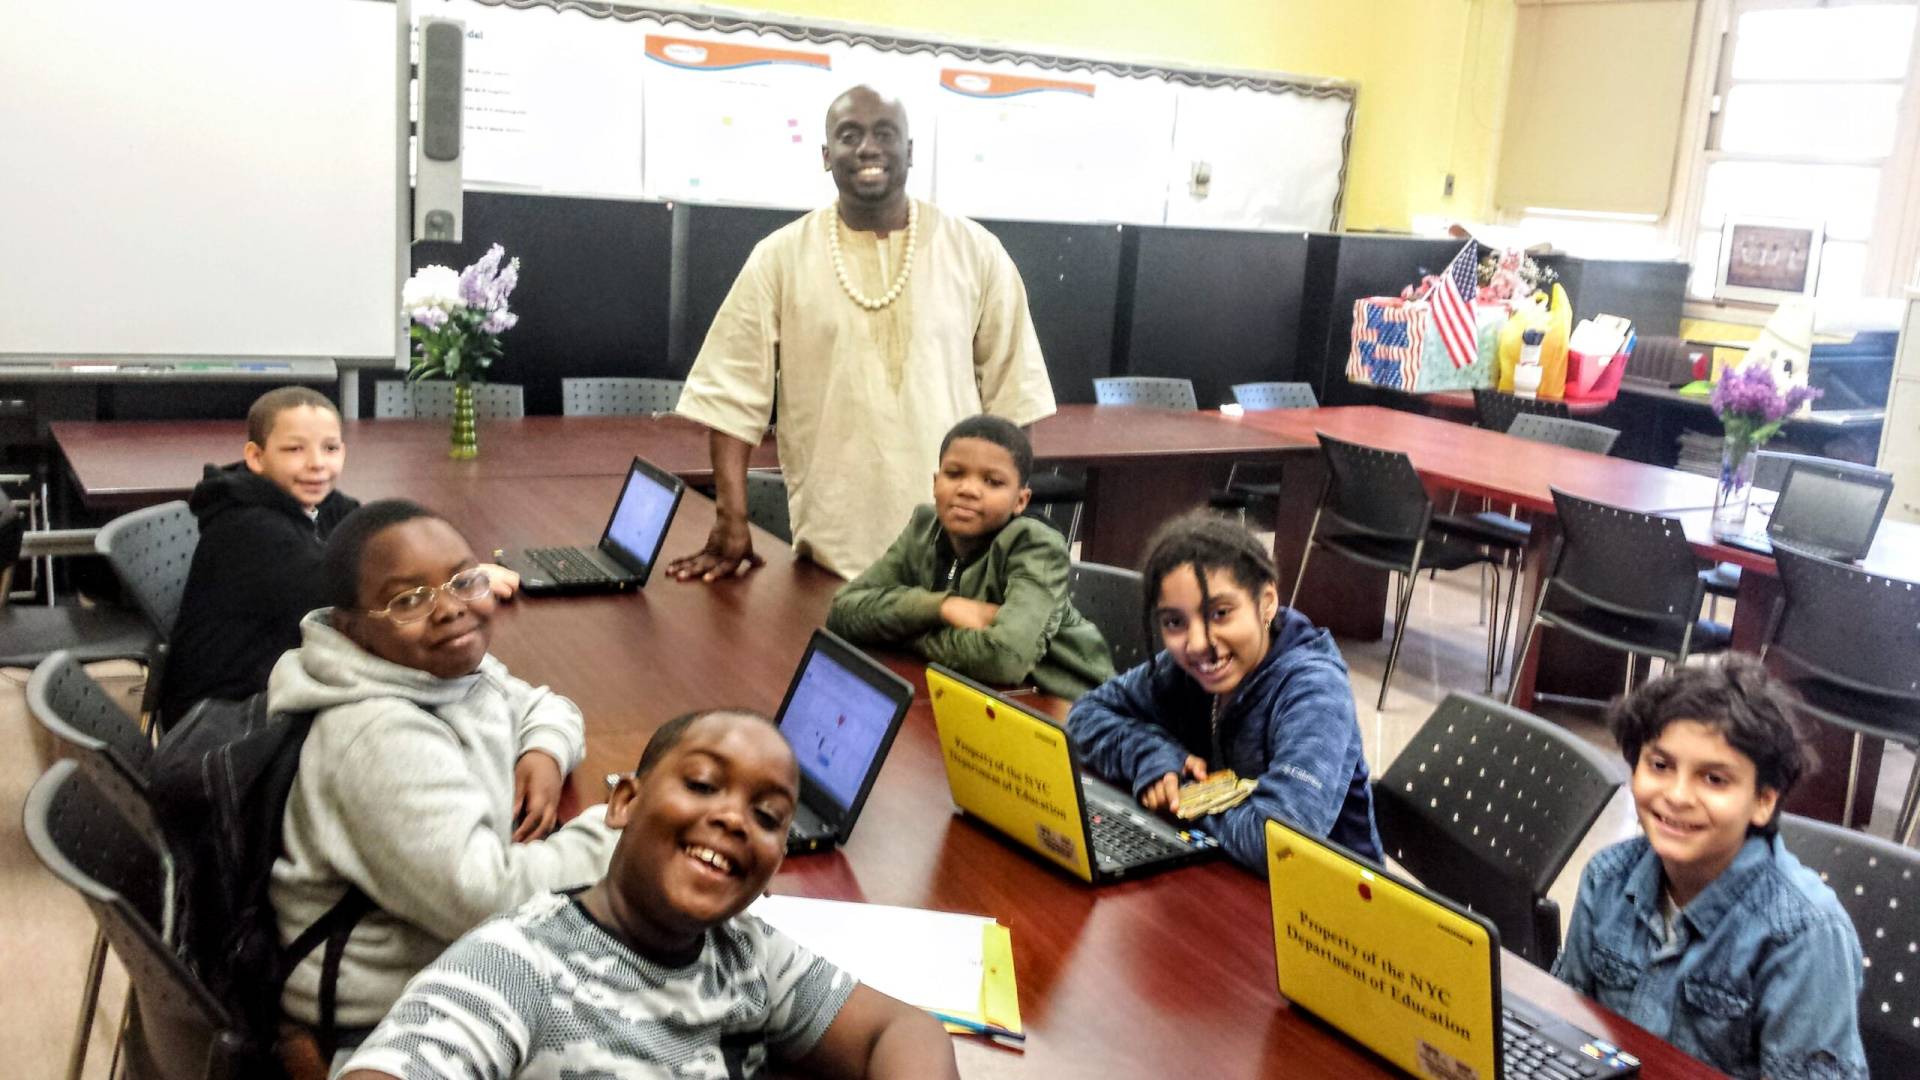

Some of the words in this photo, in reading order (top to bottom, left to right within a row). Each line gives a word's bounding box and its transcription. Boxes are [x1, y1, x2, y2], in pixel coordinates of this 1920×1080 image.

[950, 749, 1000, 784] Department
[1002, 781, 1012, 792] of
[1016, 786, 1066, 820] Education
[955, 737, 993, 768] Property
[995, 760, 1004, 771] of
[1007, 766, 1022, 780] the
[1024, 773, 1050, 794] NYC
[1287, 924, 1366, 983] Department
[1370, 977, 1385, 992] of
[1391, 985, 1471, 1041] Education
[1300, 911, 1358, 956] Property
[1362, 951, 1377, 966] of
[1381, 959, 1405, 980] the
[1410, 973, 1451, 1006] NYC
